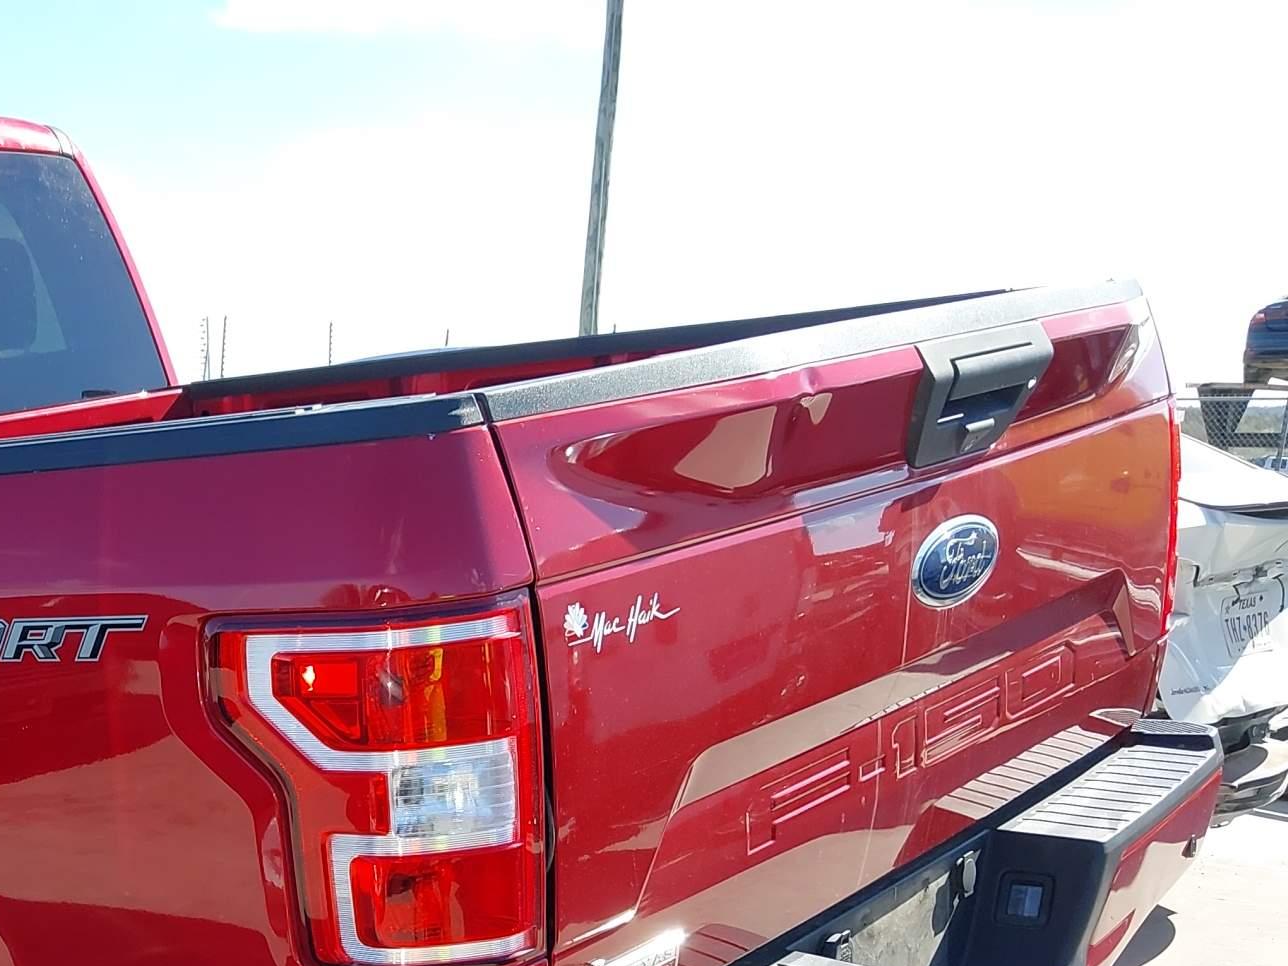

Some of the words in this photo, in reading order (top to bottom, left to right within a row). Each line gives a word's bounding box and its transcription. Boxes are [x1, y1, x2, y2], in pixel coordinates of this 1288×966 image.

[940, 532, 991, 589] Ford
[568, 611, 625, 653] Mac
[626, 592, 680, 643] Haik
[1238, 597, 1257, 610] TEXAS
[745, 640, 1074, 855] F-150
